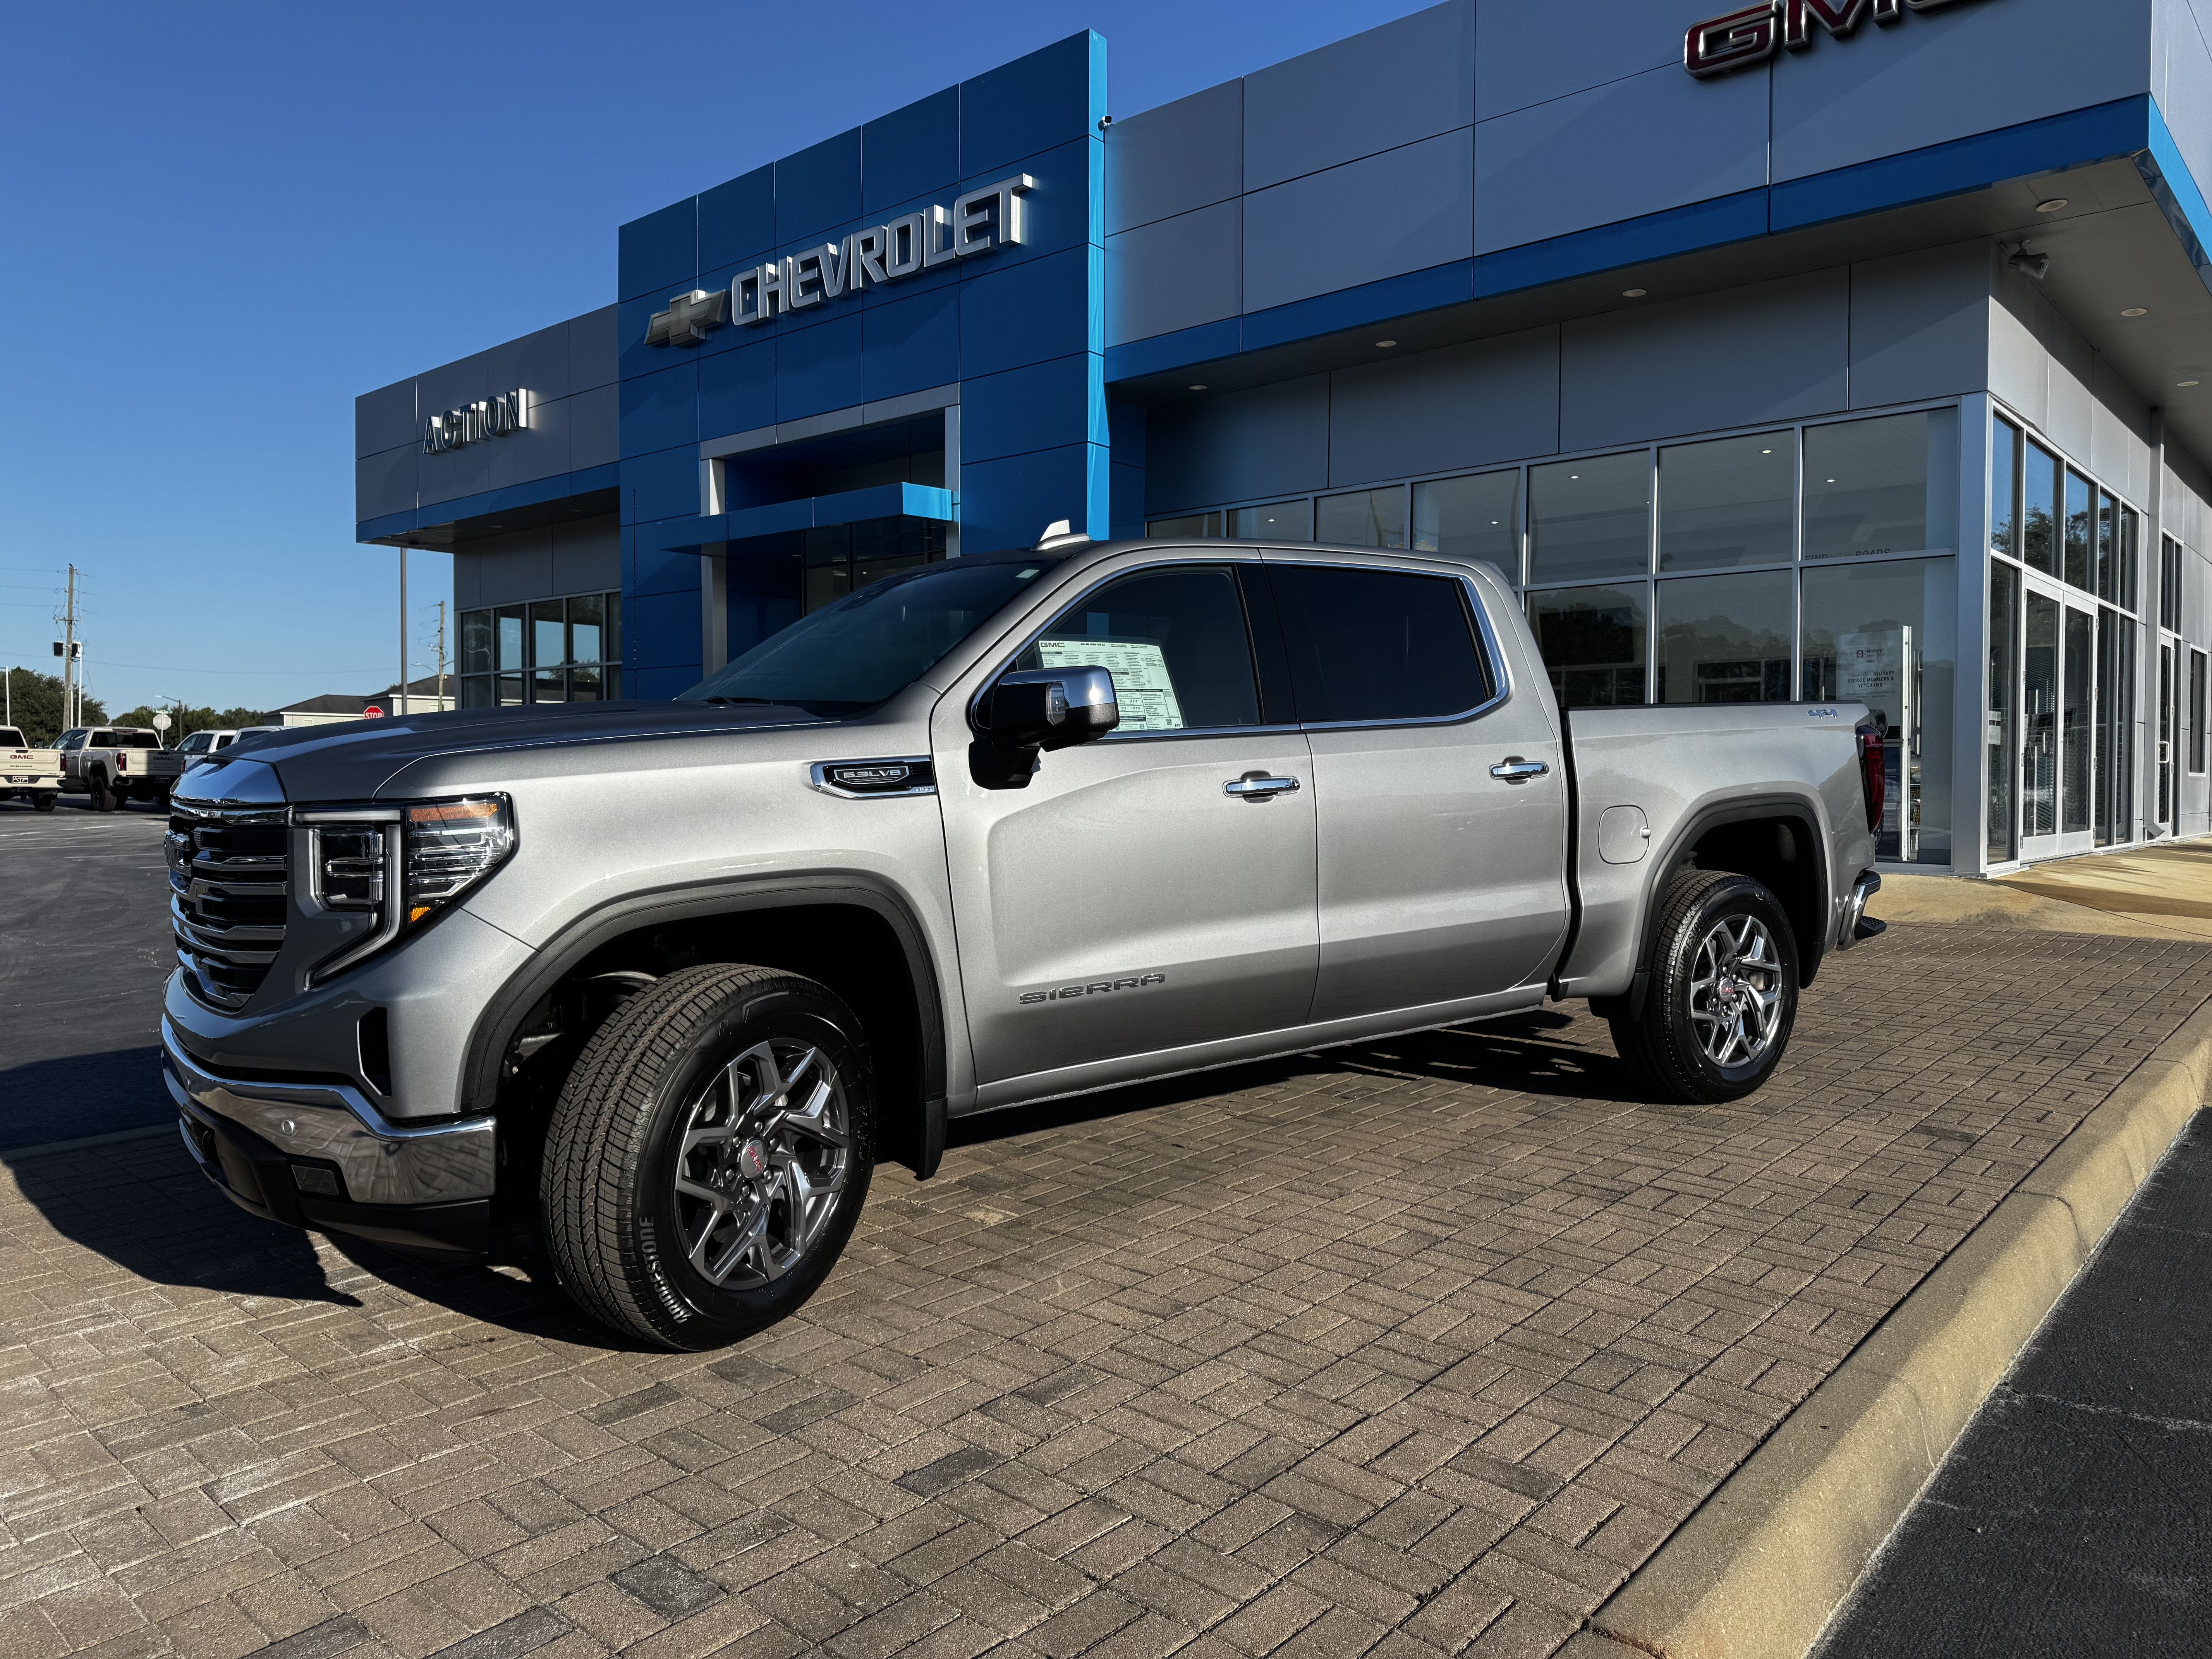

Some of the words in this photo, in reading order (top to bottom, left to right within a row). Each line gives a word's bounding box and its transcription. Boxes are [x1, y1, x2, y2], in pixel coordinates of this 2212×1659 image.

[1683, 0, 1959, 78] GM
[732, 172, 1033, 326] CHEVROLET
[422, 388, 527, 454] ACTION
[1020, 973, 1165, 1004] SIERRA
[639, 1216, 693, 1324] BRIDGESTONE
